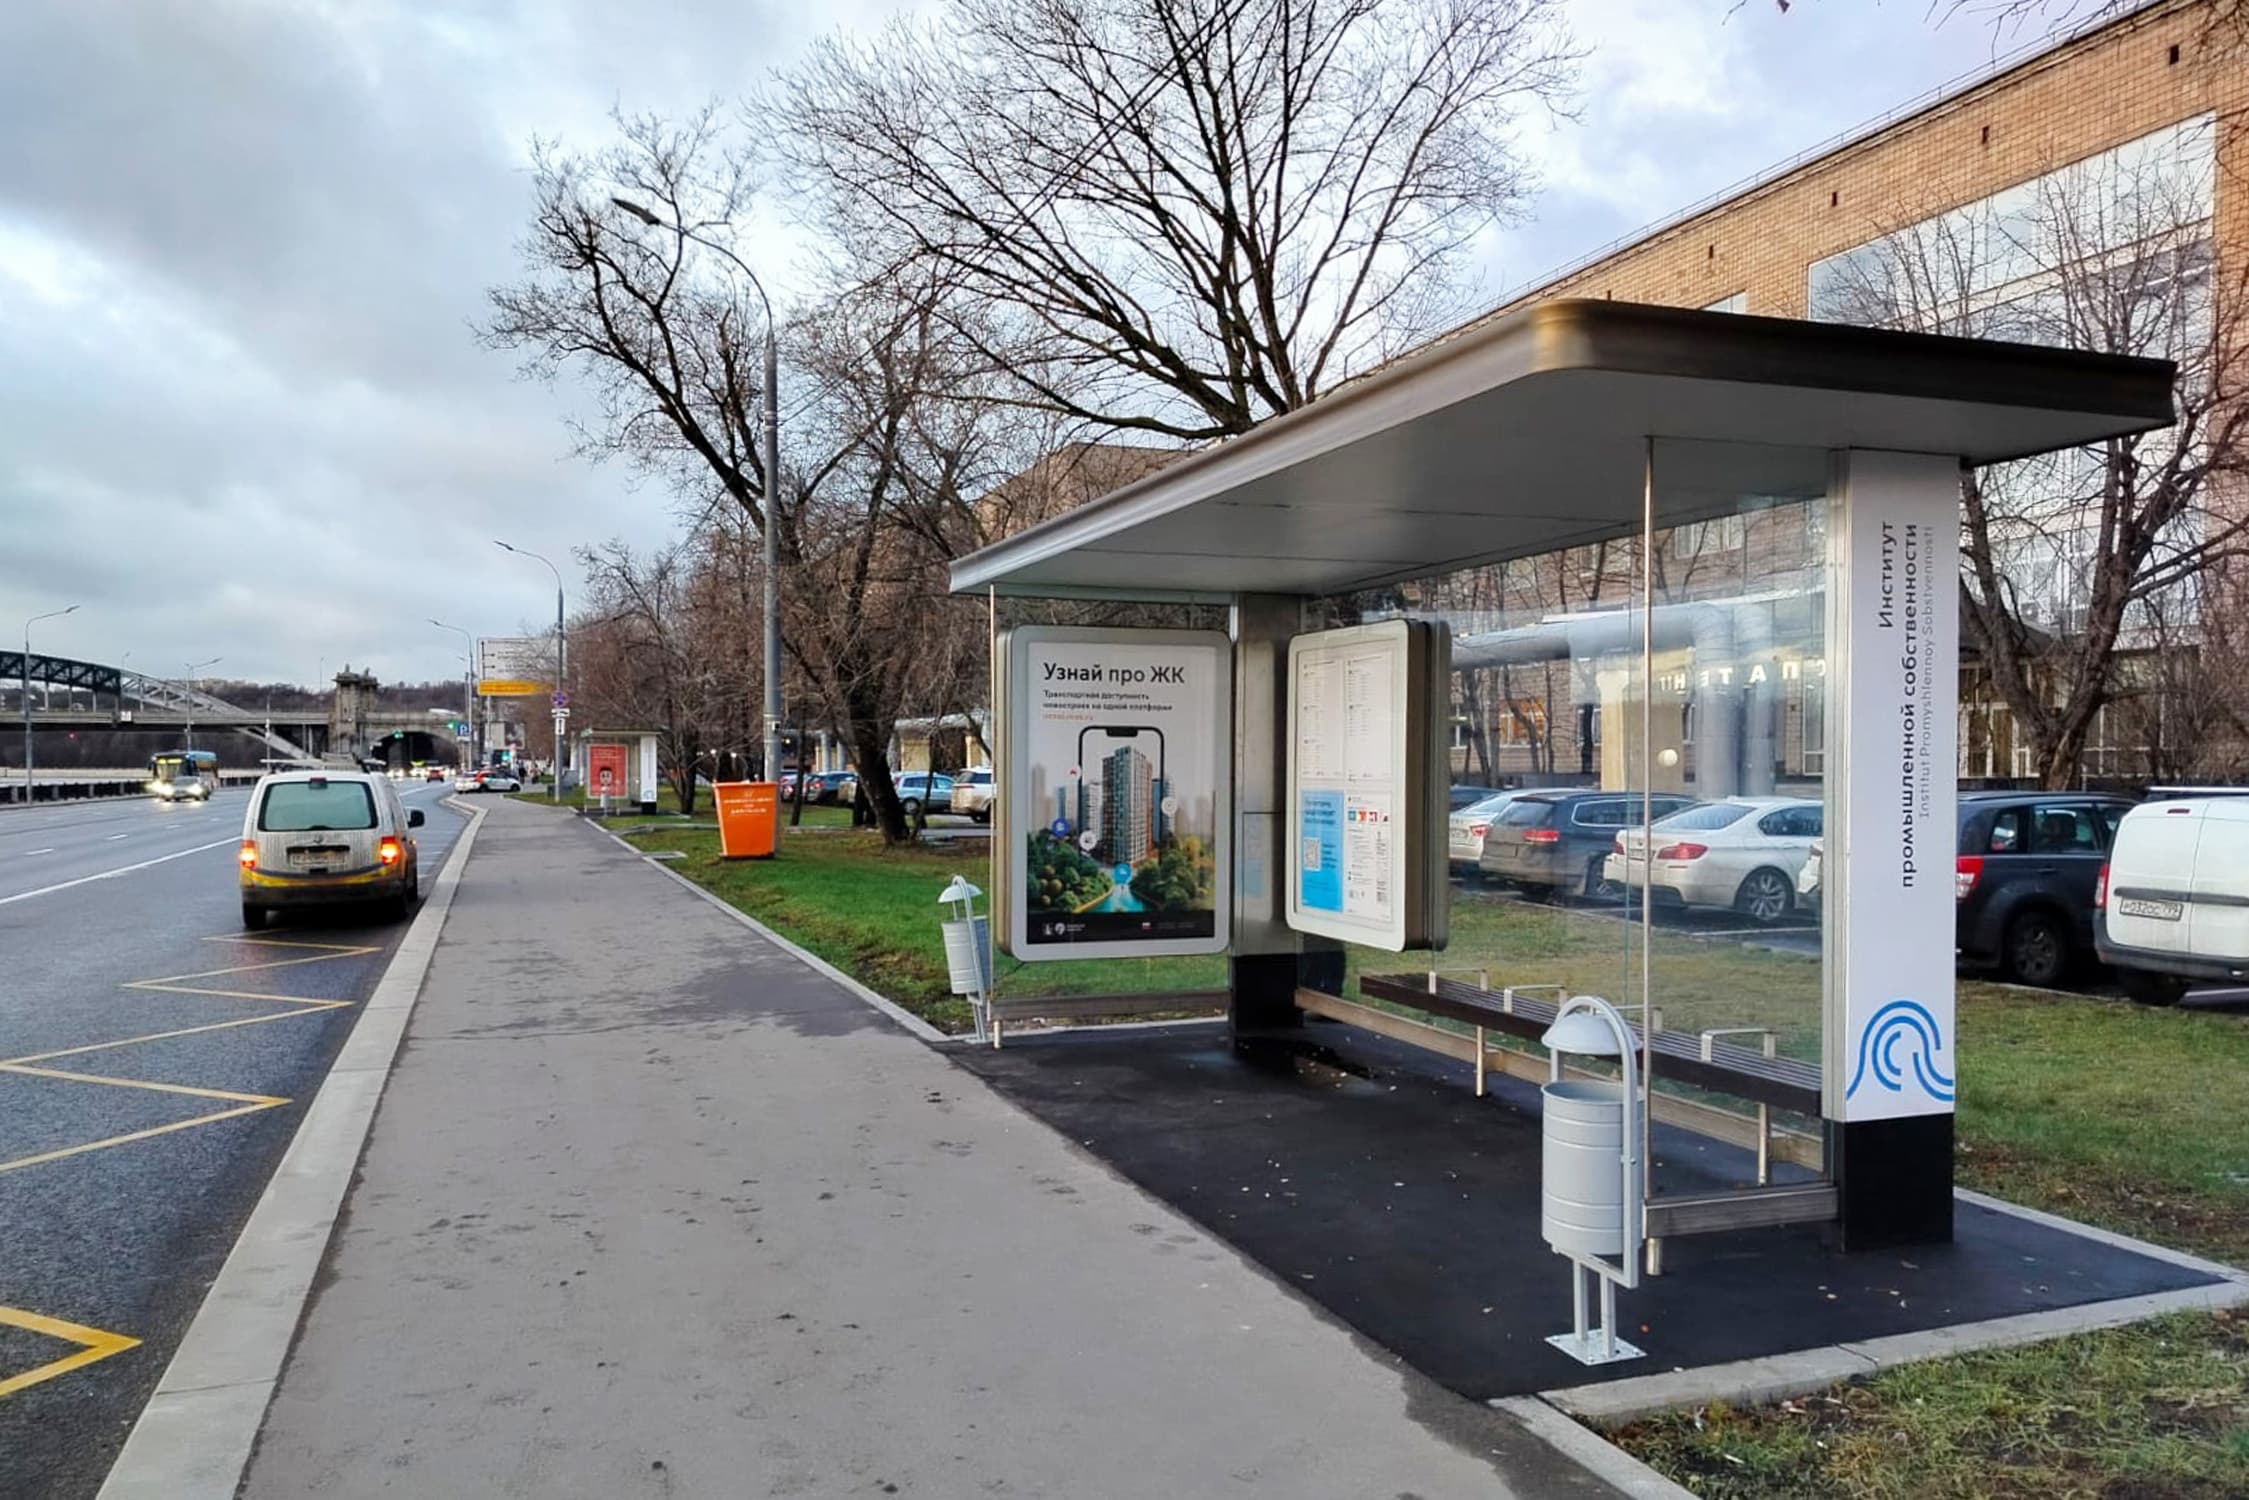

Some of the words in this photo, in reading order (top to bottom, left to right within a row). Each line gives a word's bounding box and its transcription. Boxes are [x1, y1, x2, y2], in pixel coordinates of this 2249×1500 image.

[1878, 520, 1897, 629] Институт
[1901, 523, 1919, 698] собственности
[1920, 526, 1934, 636] Sobstvennosti
[1043, 662, 1102, 682] Узнай
[1109, 668, 1145, 686] про
[1150, 666, 1185, 683] ЖК
[1919, 640, 1935, 757] Promyshlennoy
[1901, 703, 1918, 888] промышленной
[1919, 762, 1931, 819] Institut
